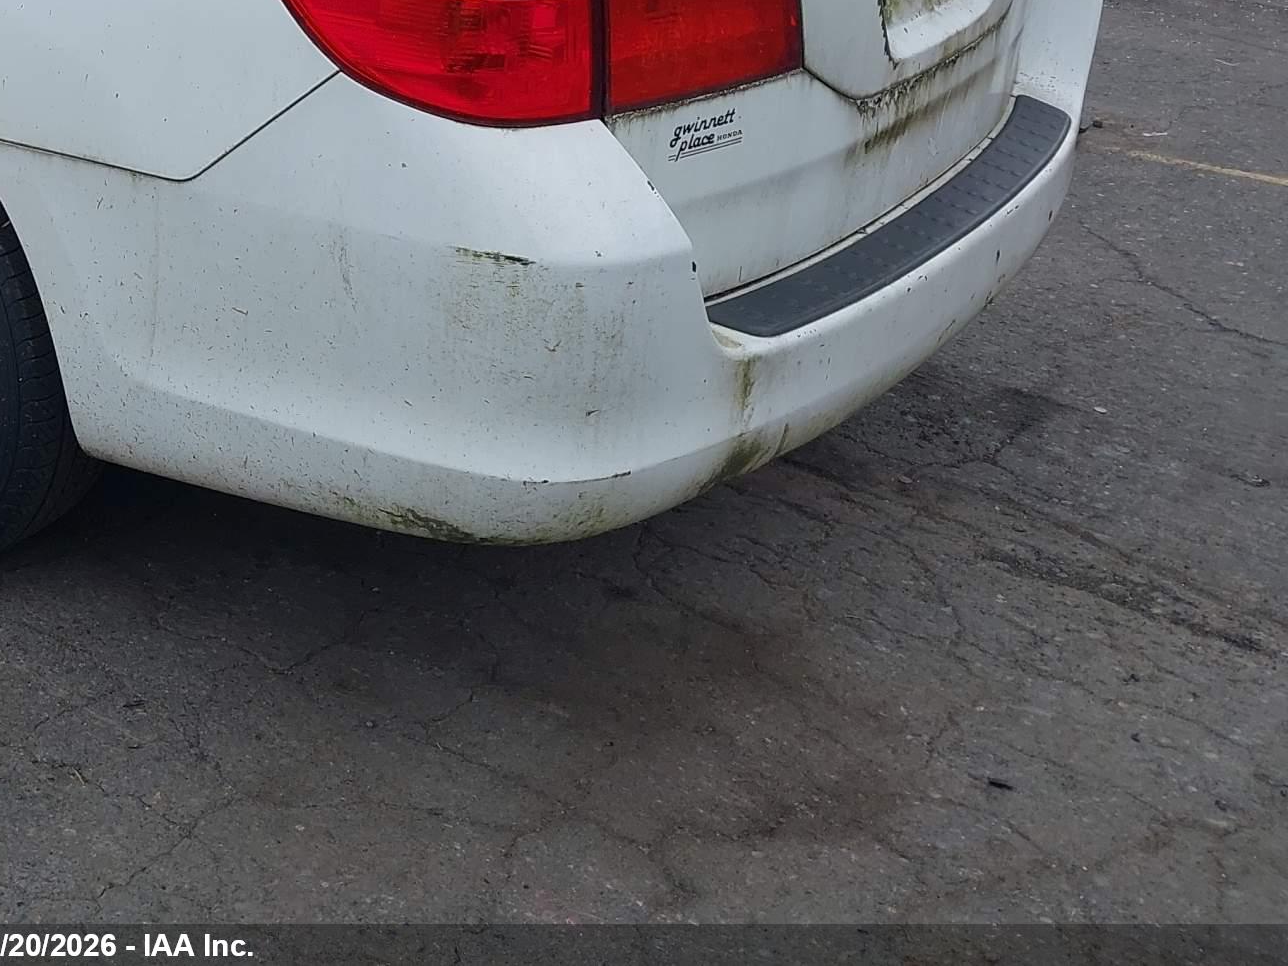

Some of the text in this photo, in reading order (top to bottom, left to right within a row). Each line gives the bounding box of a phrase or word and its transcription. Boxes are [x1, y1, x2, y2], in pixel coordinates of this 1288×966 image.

[670, 108, 736, 147] gwinnett
[675, 130, 743, 162] place HONDA
